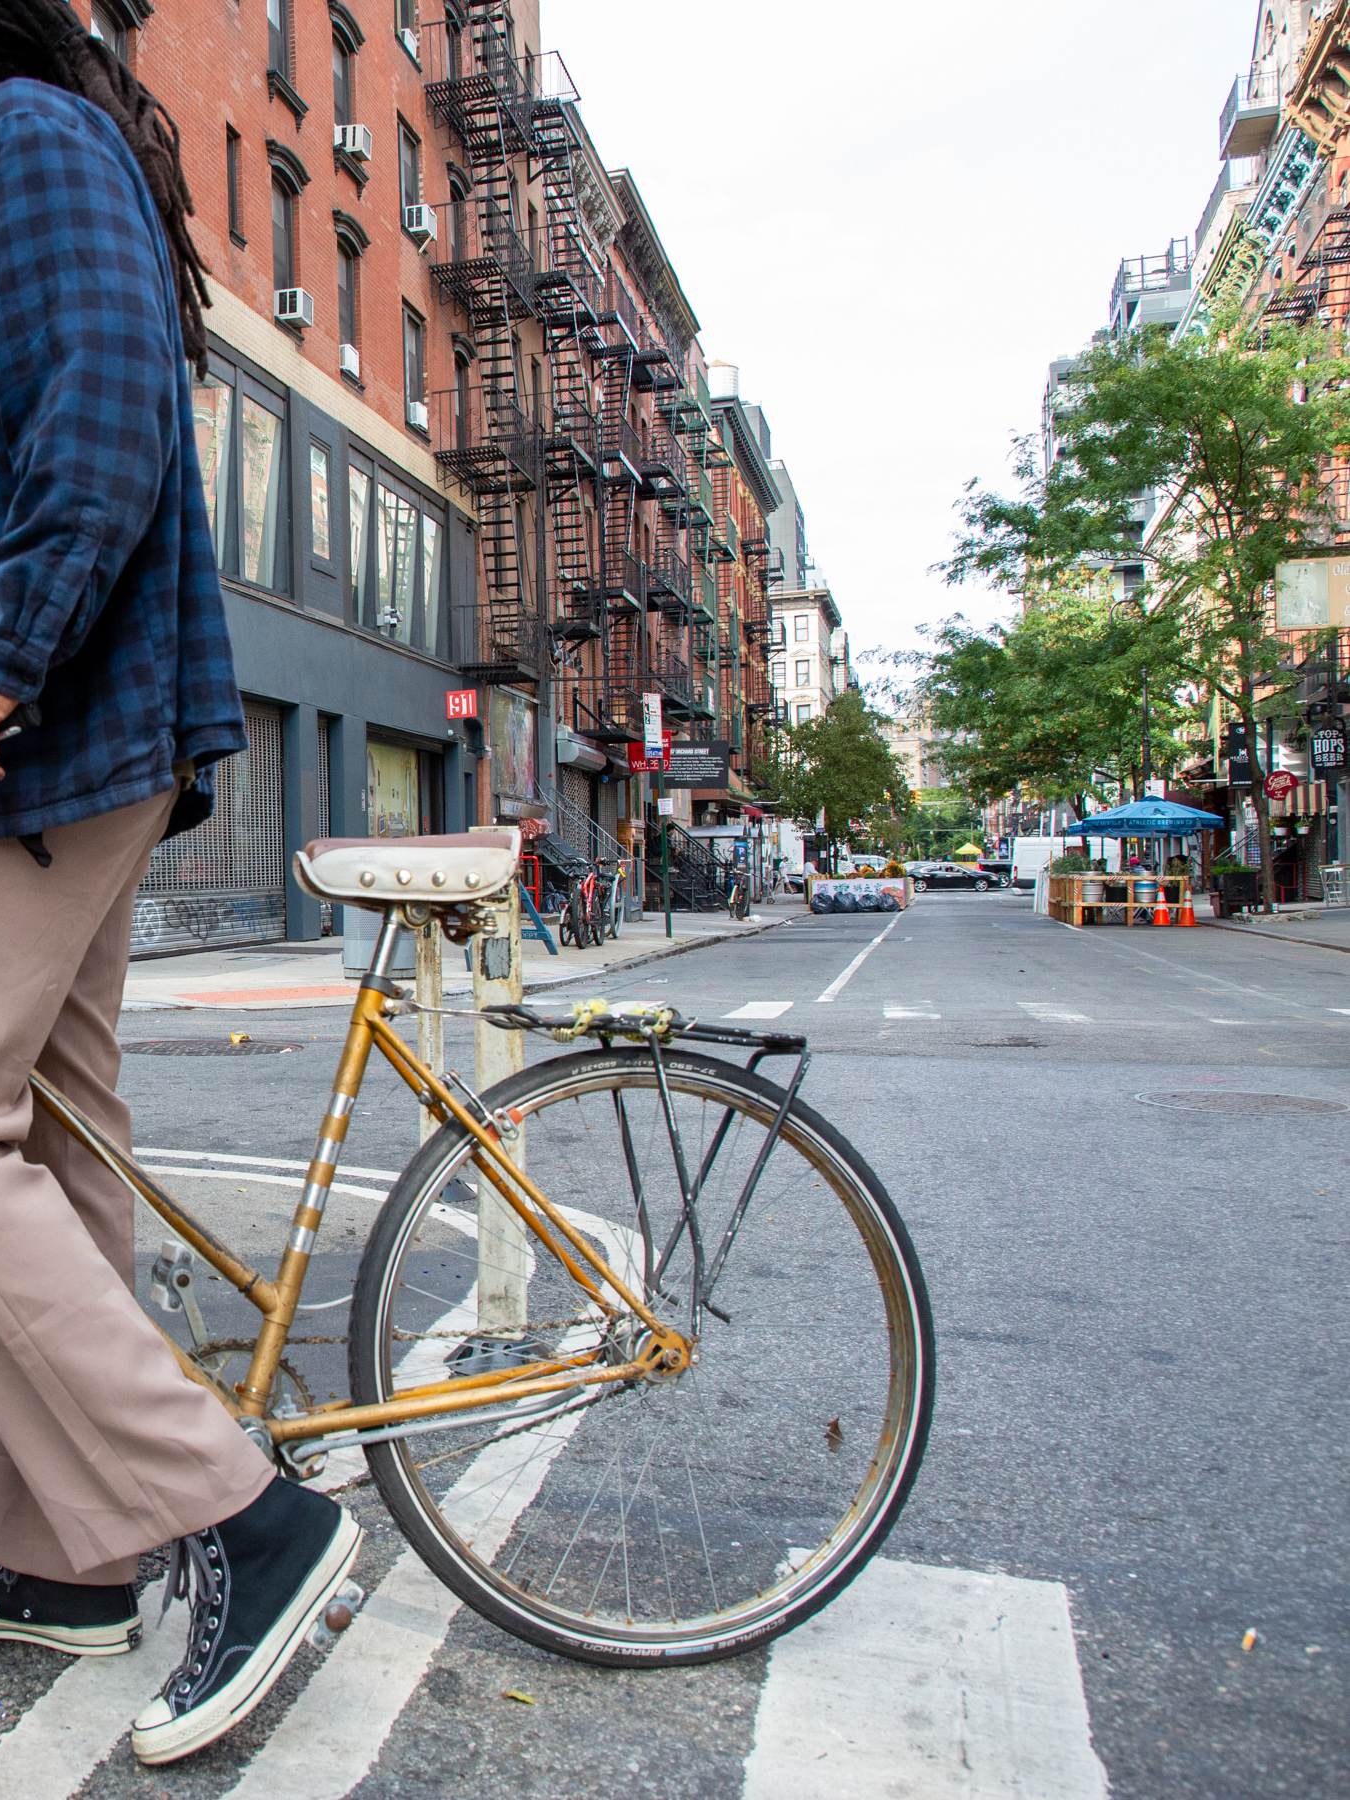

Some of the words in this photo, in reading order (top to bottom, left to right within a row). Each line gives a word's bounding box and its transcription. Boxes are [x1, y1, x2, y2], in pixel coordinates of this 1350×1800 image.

[451, 693, 471, 715] 91
[1317, 729, 1339, 739] TOP
[1313, 738, 1345, 755] HOPS
[1315, 753, 1344, 762] BEER
[669, 1061, 717, 1076] 37-590
[718, 1615, 787, 1649] SCHWALBE
[582, 1641, 662, 1657] MARATHON
